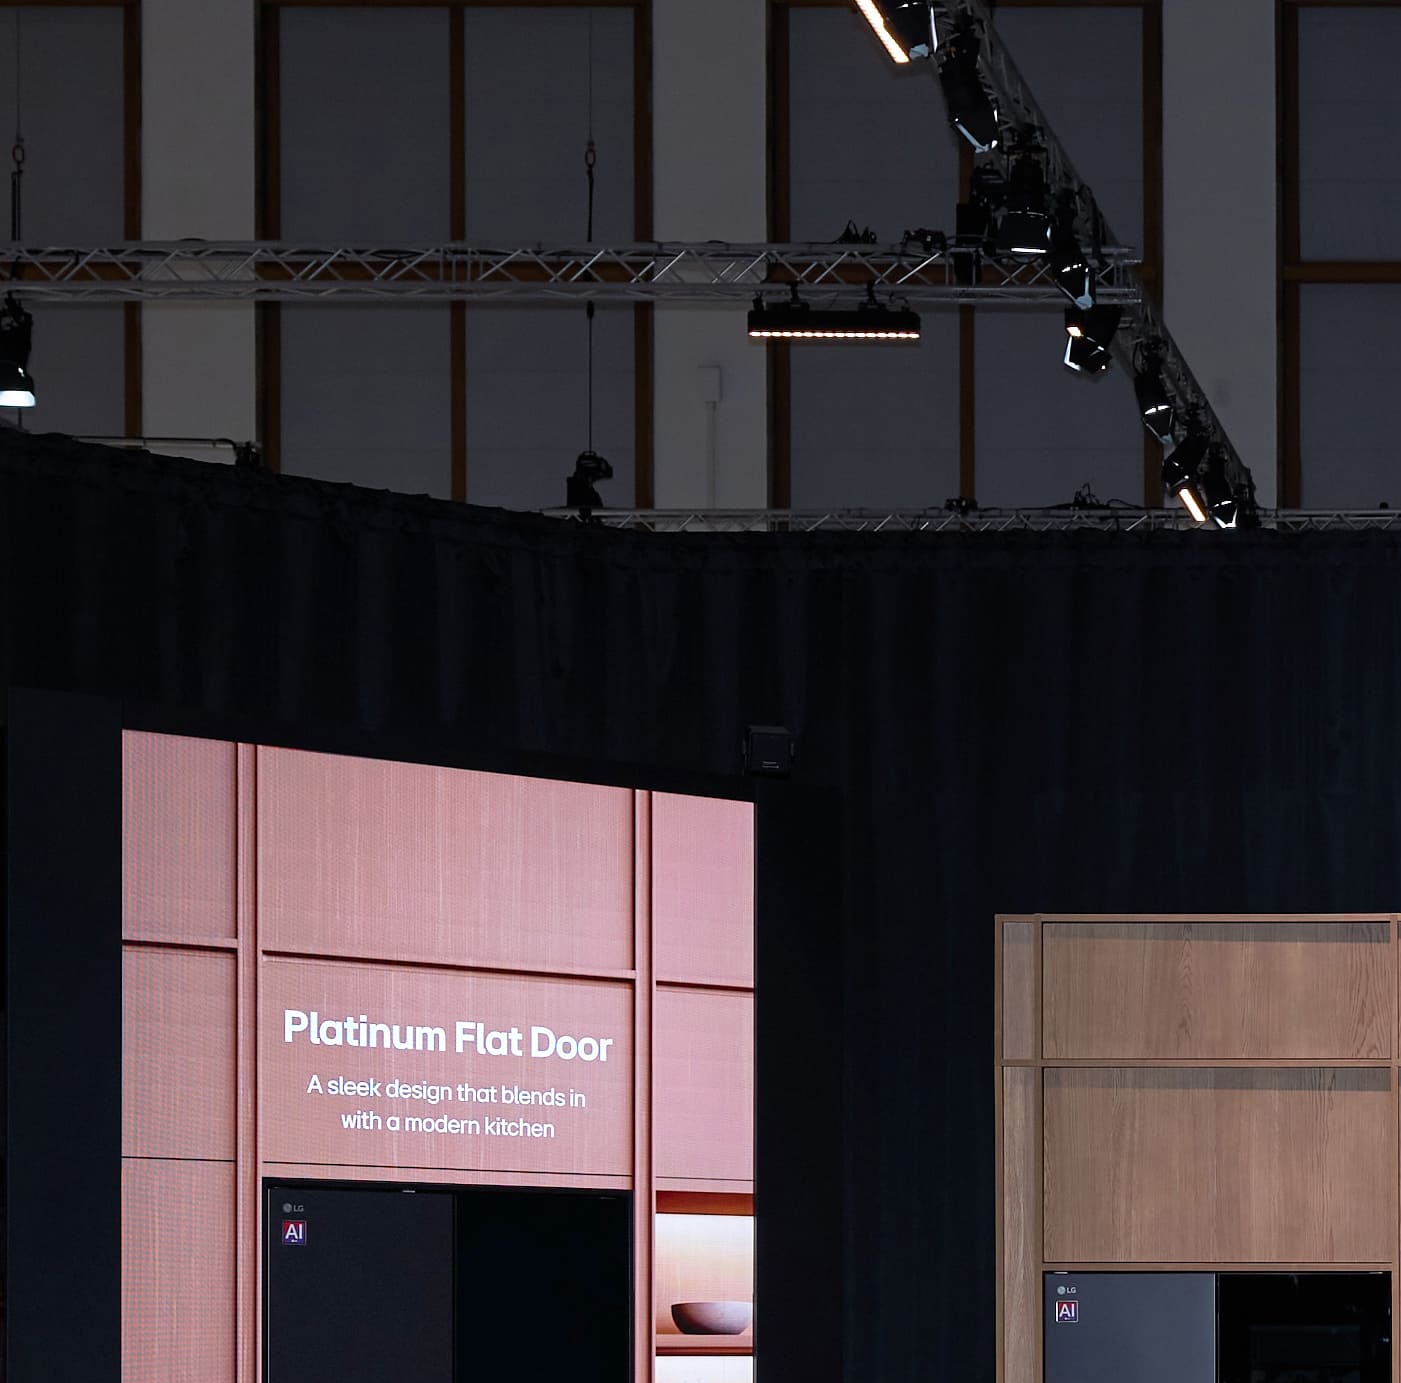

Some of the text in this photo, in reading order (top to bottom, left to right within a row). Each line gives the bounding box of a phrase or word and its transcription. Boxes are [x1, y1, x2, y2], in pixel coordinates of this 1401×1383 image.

[284, 1009, 614, 1062] Platinum Flat Door
[307, 1074, 586, 1108] A sleek design that blends in
[341, 1111, 555, 1138] with a modern kitchen
[285, 1223, 303, 1240] AI
[1058, 1303, 1075, 1318] AI
